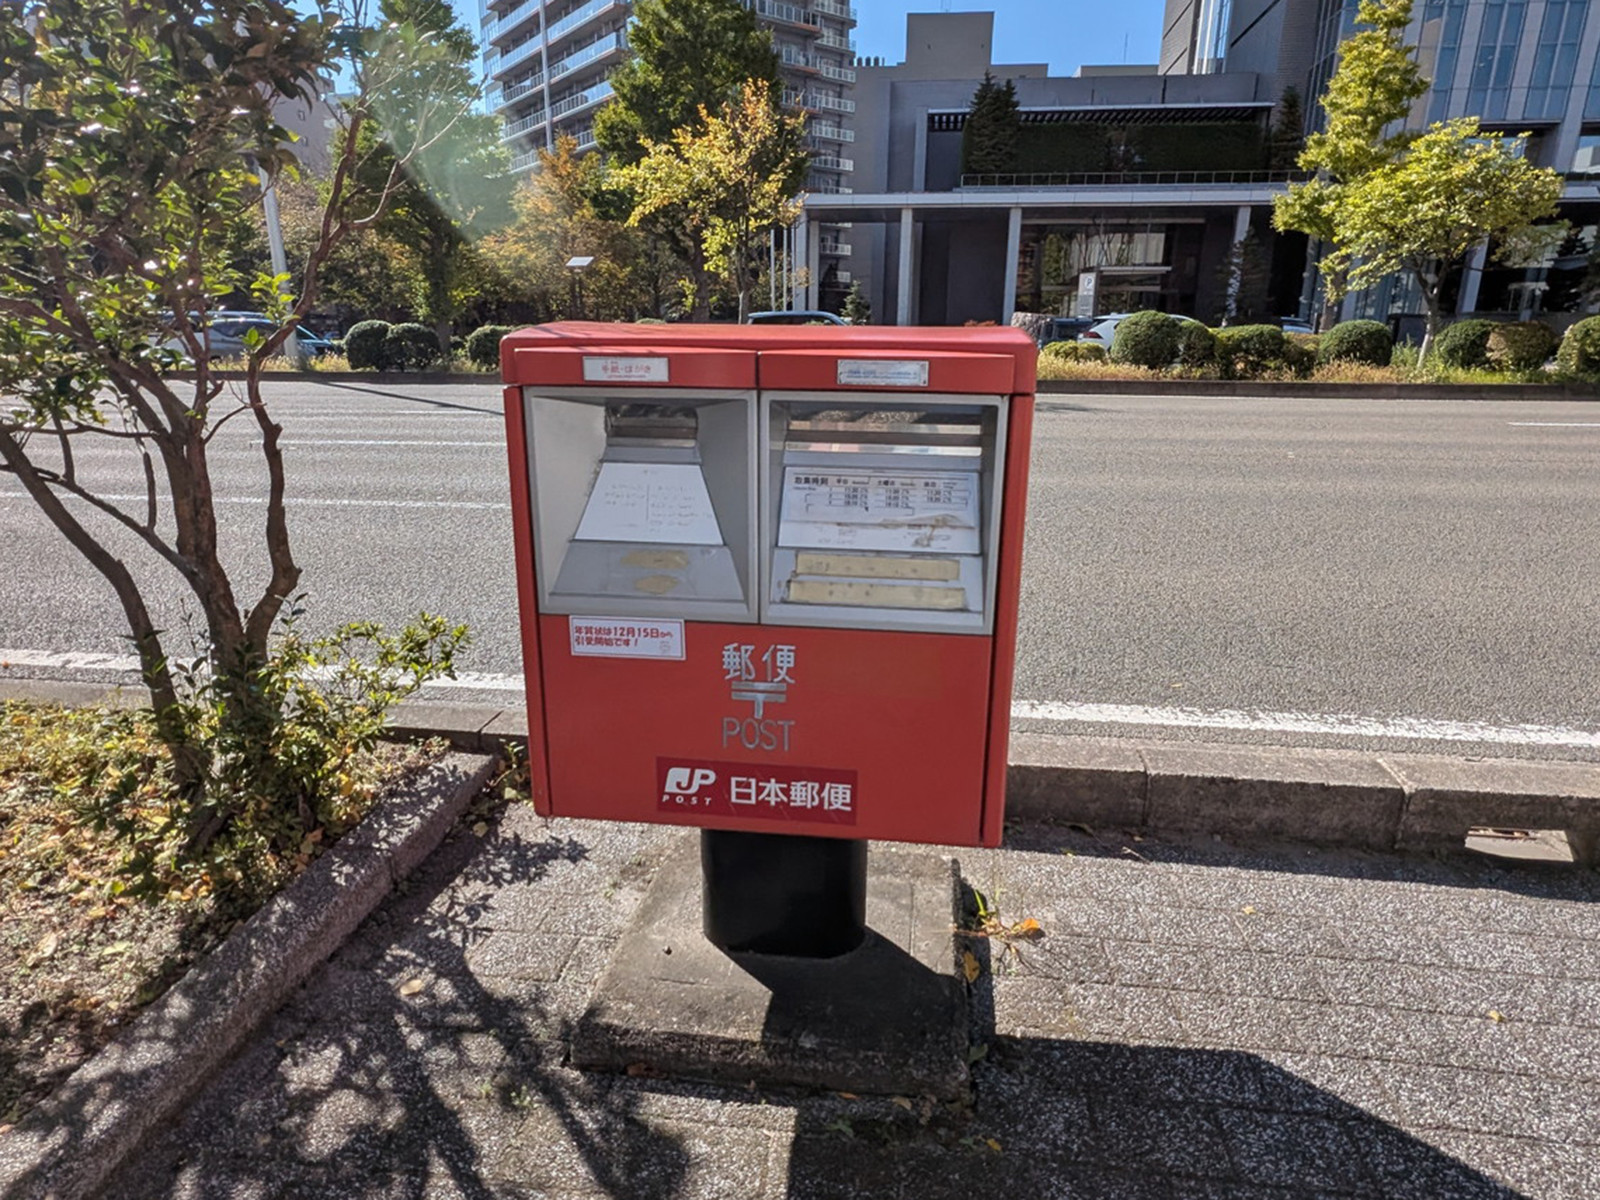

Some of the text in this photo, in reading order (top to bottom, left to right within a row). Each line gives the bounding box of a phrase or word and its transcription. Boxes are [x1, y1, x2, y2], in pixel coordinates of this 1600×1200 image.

[722, 643, 796, 684] 郵便
[722, 717, 796, 751] POST
[662, 794, 712, 806] POST
[730, 776, 853, 812] 日本郵便
